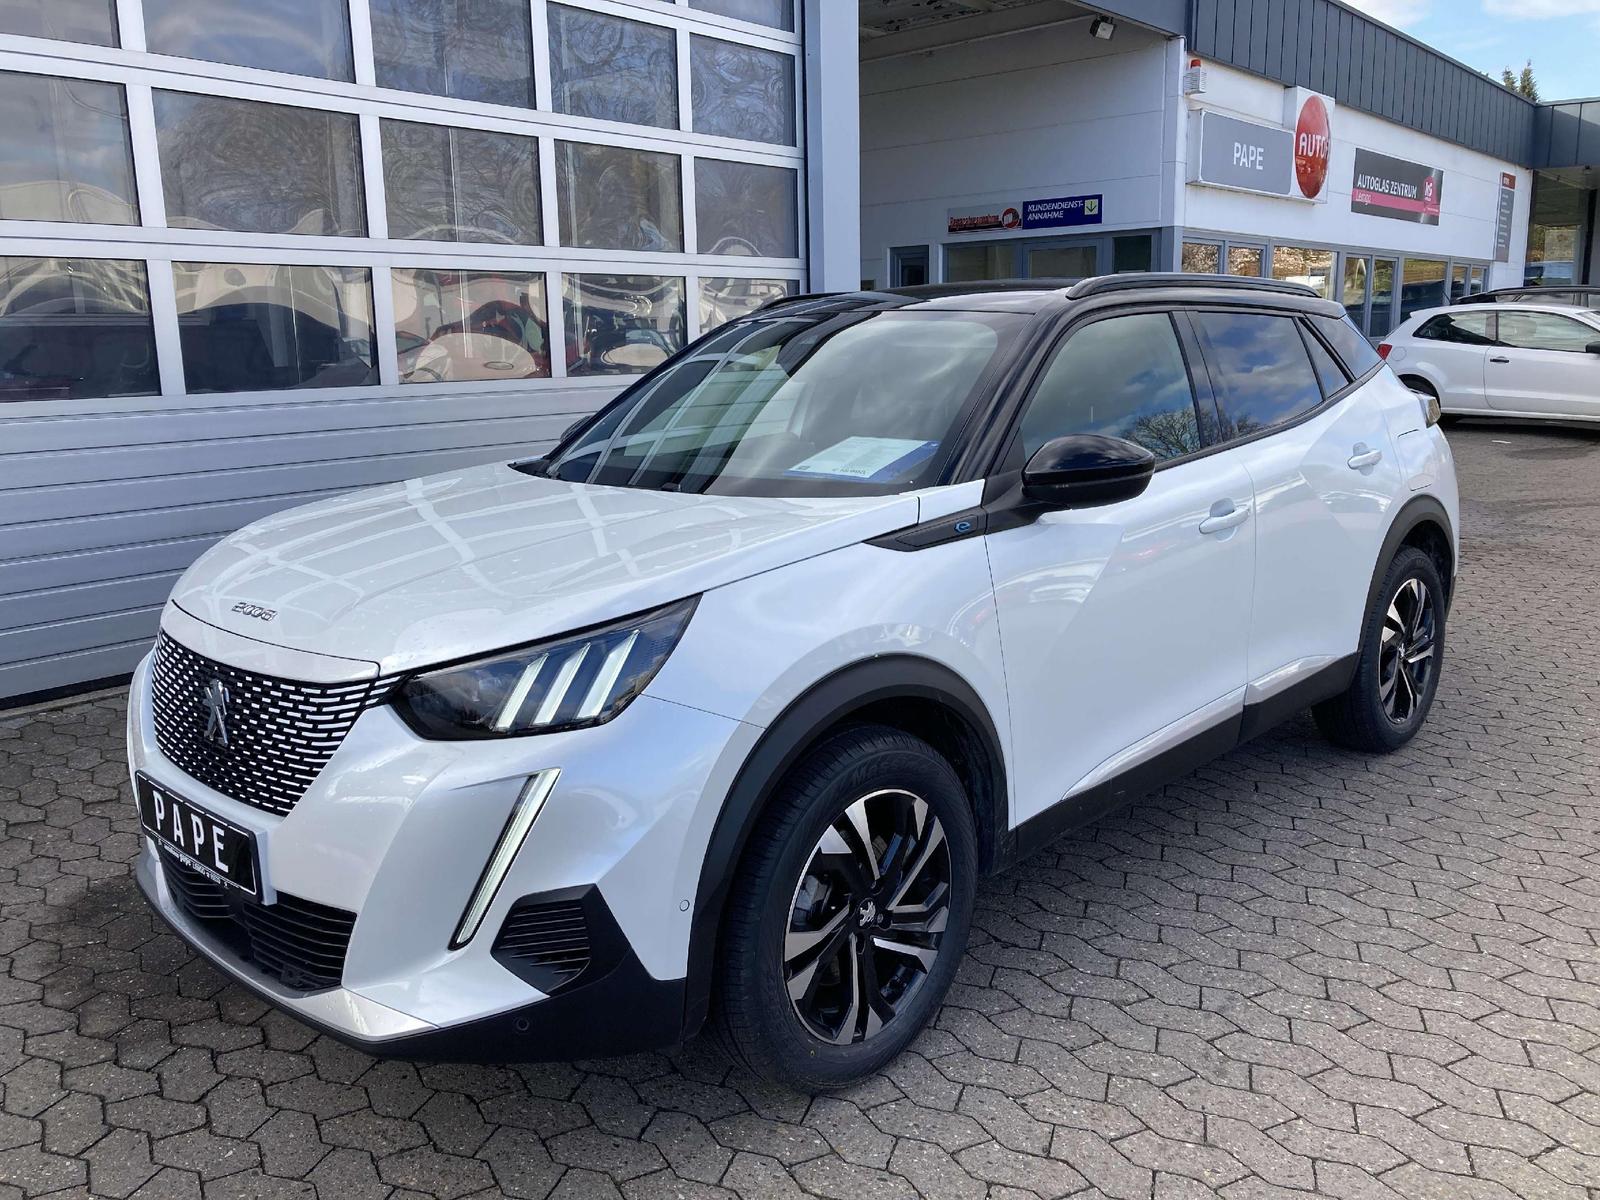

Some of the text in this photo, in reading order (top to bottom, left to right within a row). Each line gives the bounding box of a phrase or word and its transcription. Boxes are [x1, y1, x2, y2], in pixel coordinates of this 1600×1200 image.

[1233, 142, 1265, 170] PAPE
[1357, 174, 1418, 198] AUTOGLAS ZENTRUM
[1027, 200, 1084, 212] KUNDENDIENST-
[1027, 211, 1064, 221] ANNAHME
[231, 602, 278, 621] 2008
[152, 790, 229, 873] PAPE
